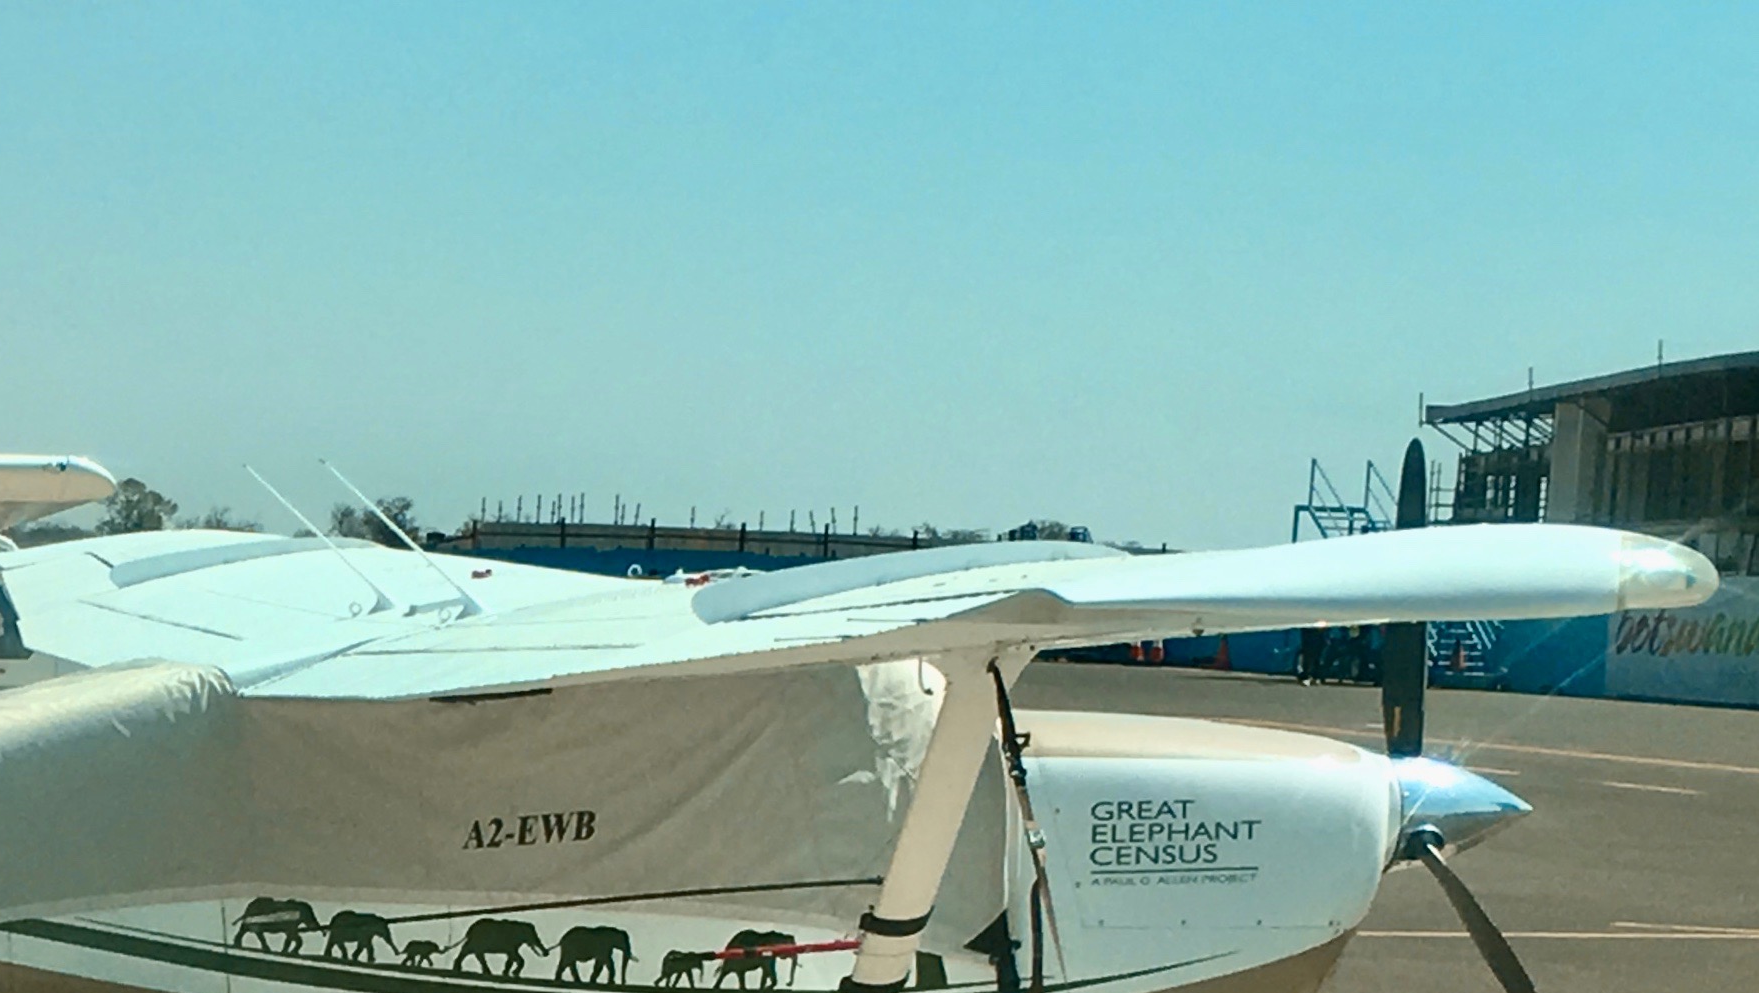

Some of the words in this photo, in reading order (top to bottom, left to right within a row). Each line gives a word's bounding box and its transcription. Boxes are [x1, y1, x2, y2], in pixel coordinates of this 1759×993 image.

[1090, 799, 1195, 821] GREAT
[462, 810, 596, 849] A2-EWB
[1091, 820, 1262, 844] ELEPHANT
[1090, 843, 1218, 866] CENSUS
